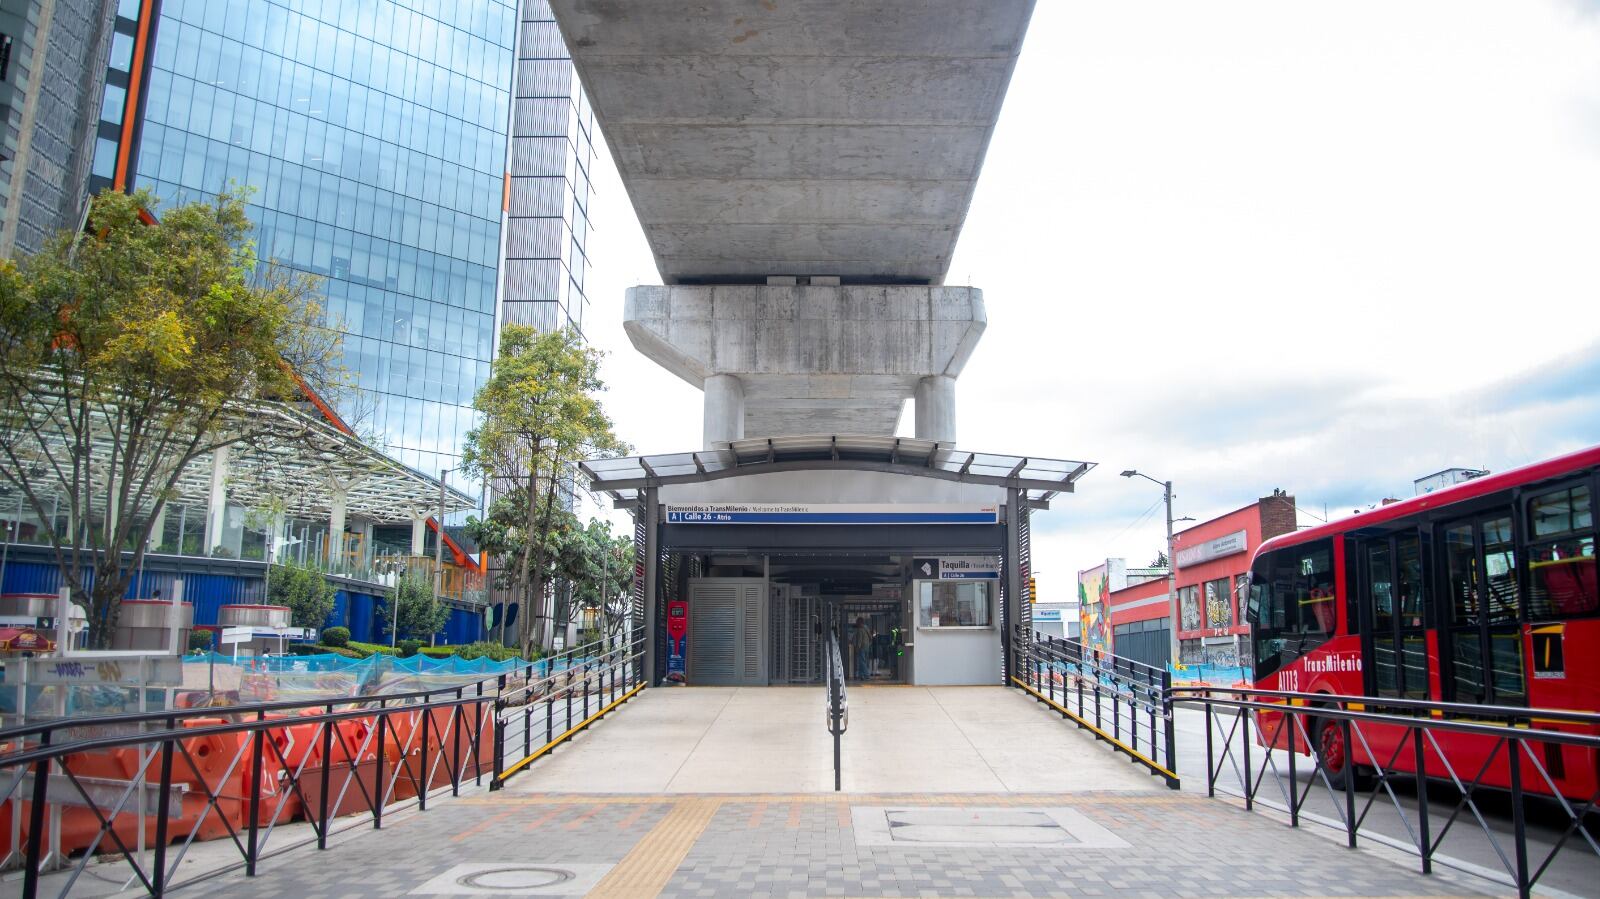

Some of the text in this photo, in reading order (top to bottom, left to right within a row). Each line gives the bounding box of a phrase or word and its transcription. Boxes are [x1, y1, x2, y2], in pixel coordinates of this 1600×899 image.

[671, 512, 677, 520] A
[684, 512, 702, 520] Calle
[716, 513, 732, 521] Atrio
[942, 560, 970, 570] Taquilla
[1303, 653, 1362, 672] TransMilenio
